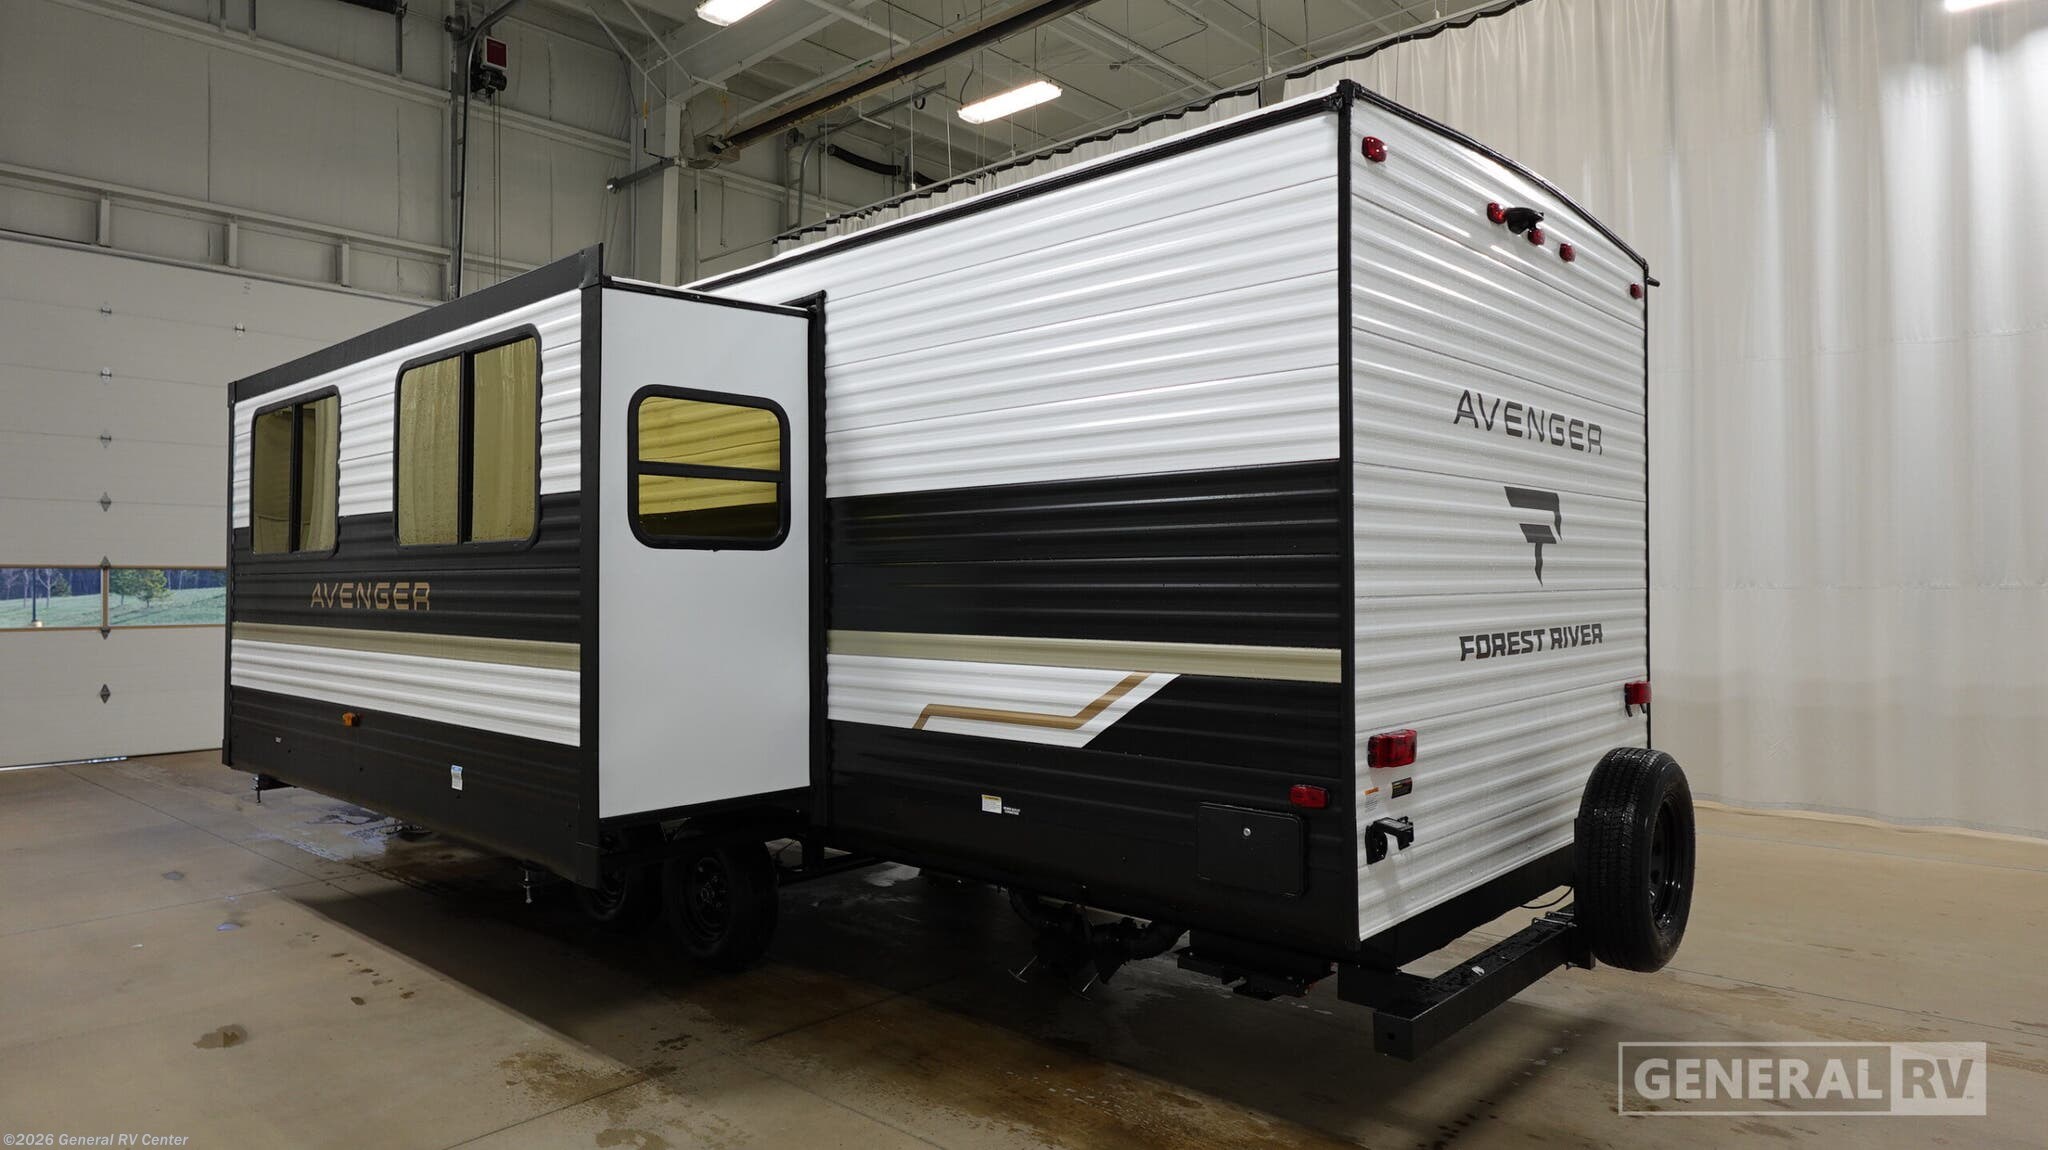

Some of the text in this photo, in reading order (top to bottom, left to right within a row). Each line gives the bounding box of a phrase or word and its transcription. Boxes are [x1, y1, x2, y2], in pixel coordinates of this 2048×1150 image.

[1453, 389, 1603, 456] AVENGER
[310, 582, 430, 611] AVENGER
[1459, 623, 1604, 662] FOREST RIVER
